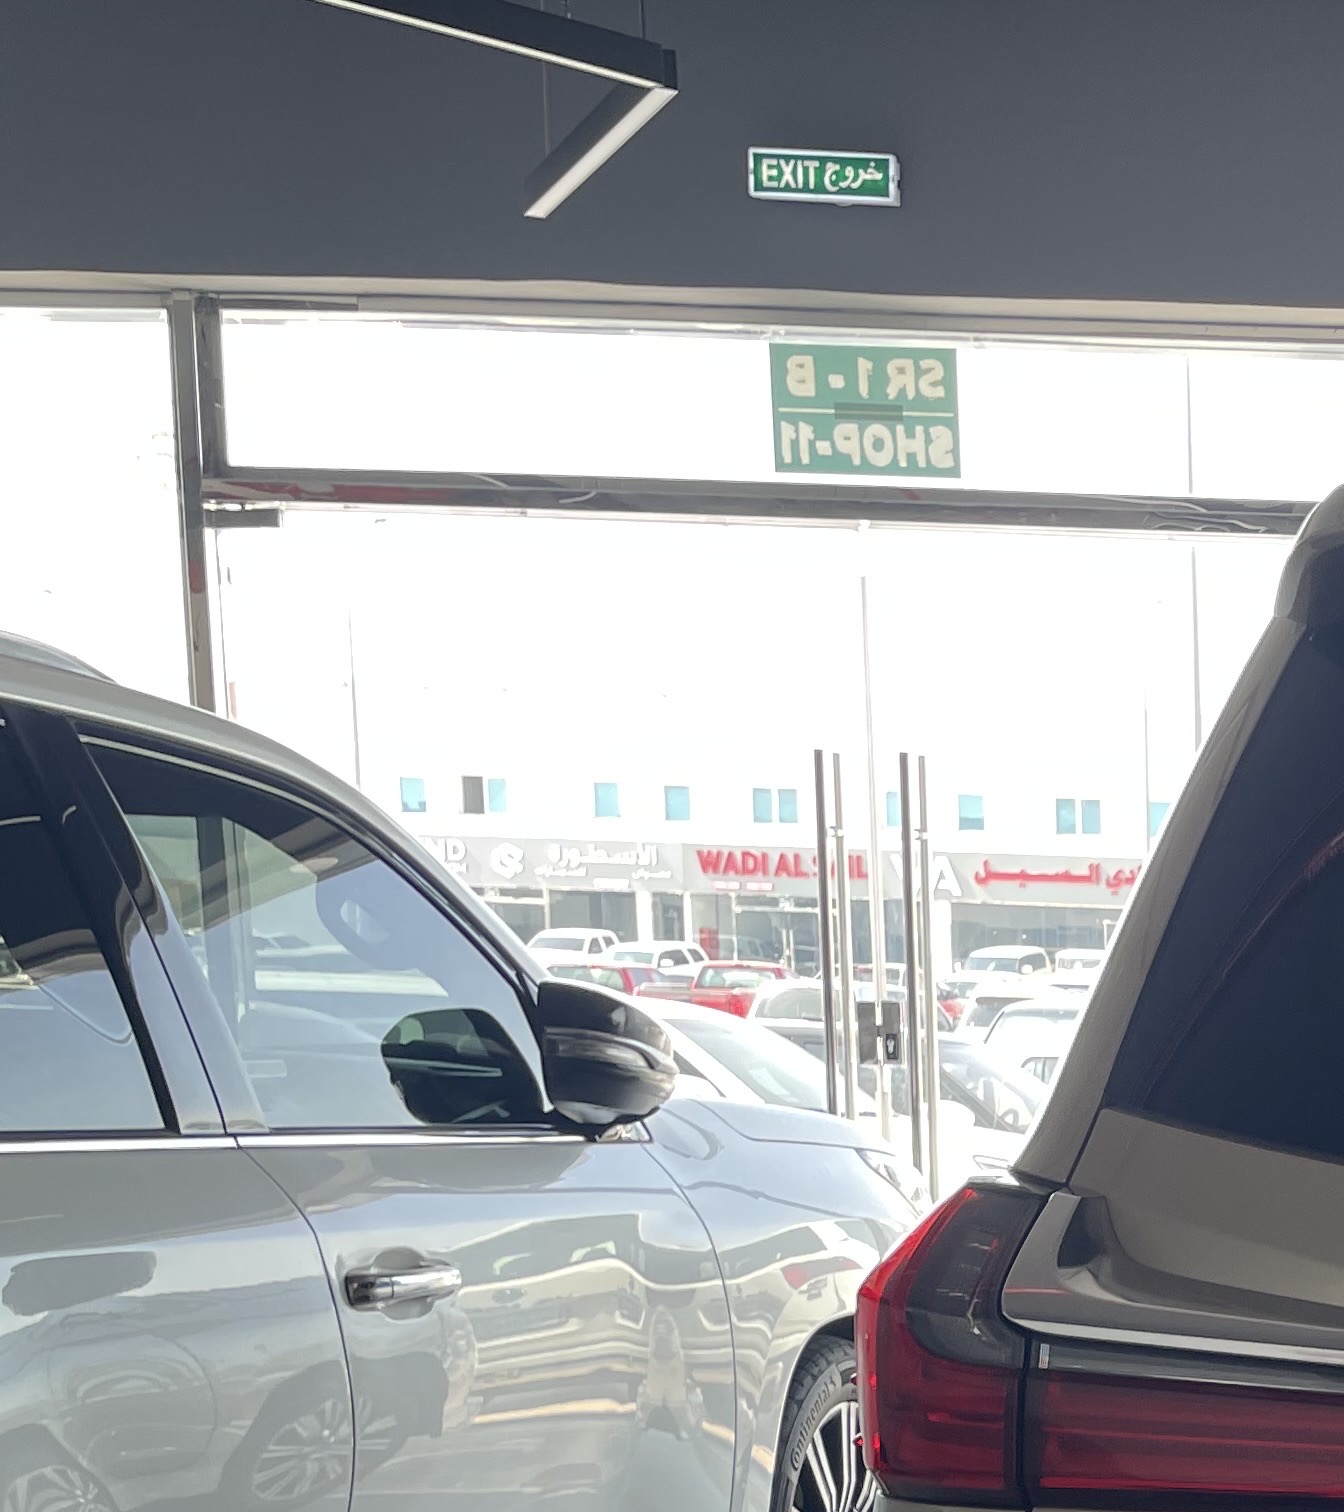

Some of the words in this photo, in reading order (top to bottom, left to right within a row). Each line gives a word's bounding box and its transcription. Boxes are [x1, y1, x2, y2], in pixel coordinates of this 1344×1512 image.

[761, 158, 820, 190] EXIT
[823, 161, 883, 192] خروج
[696, 849, 769, 877] WADI
[774, 852, 810, 879] AL
[789, 1381, 831, 1472] Continental
